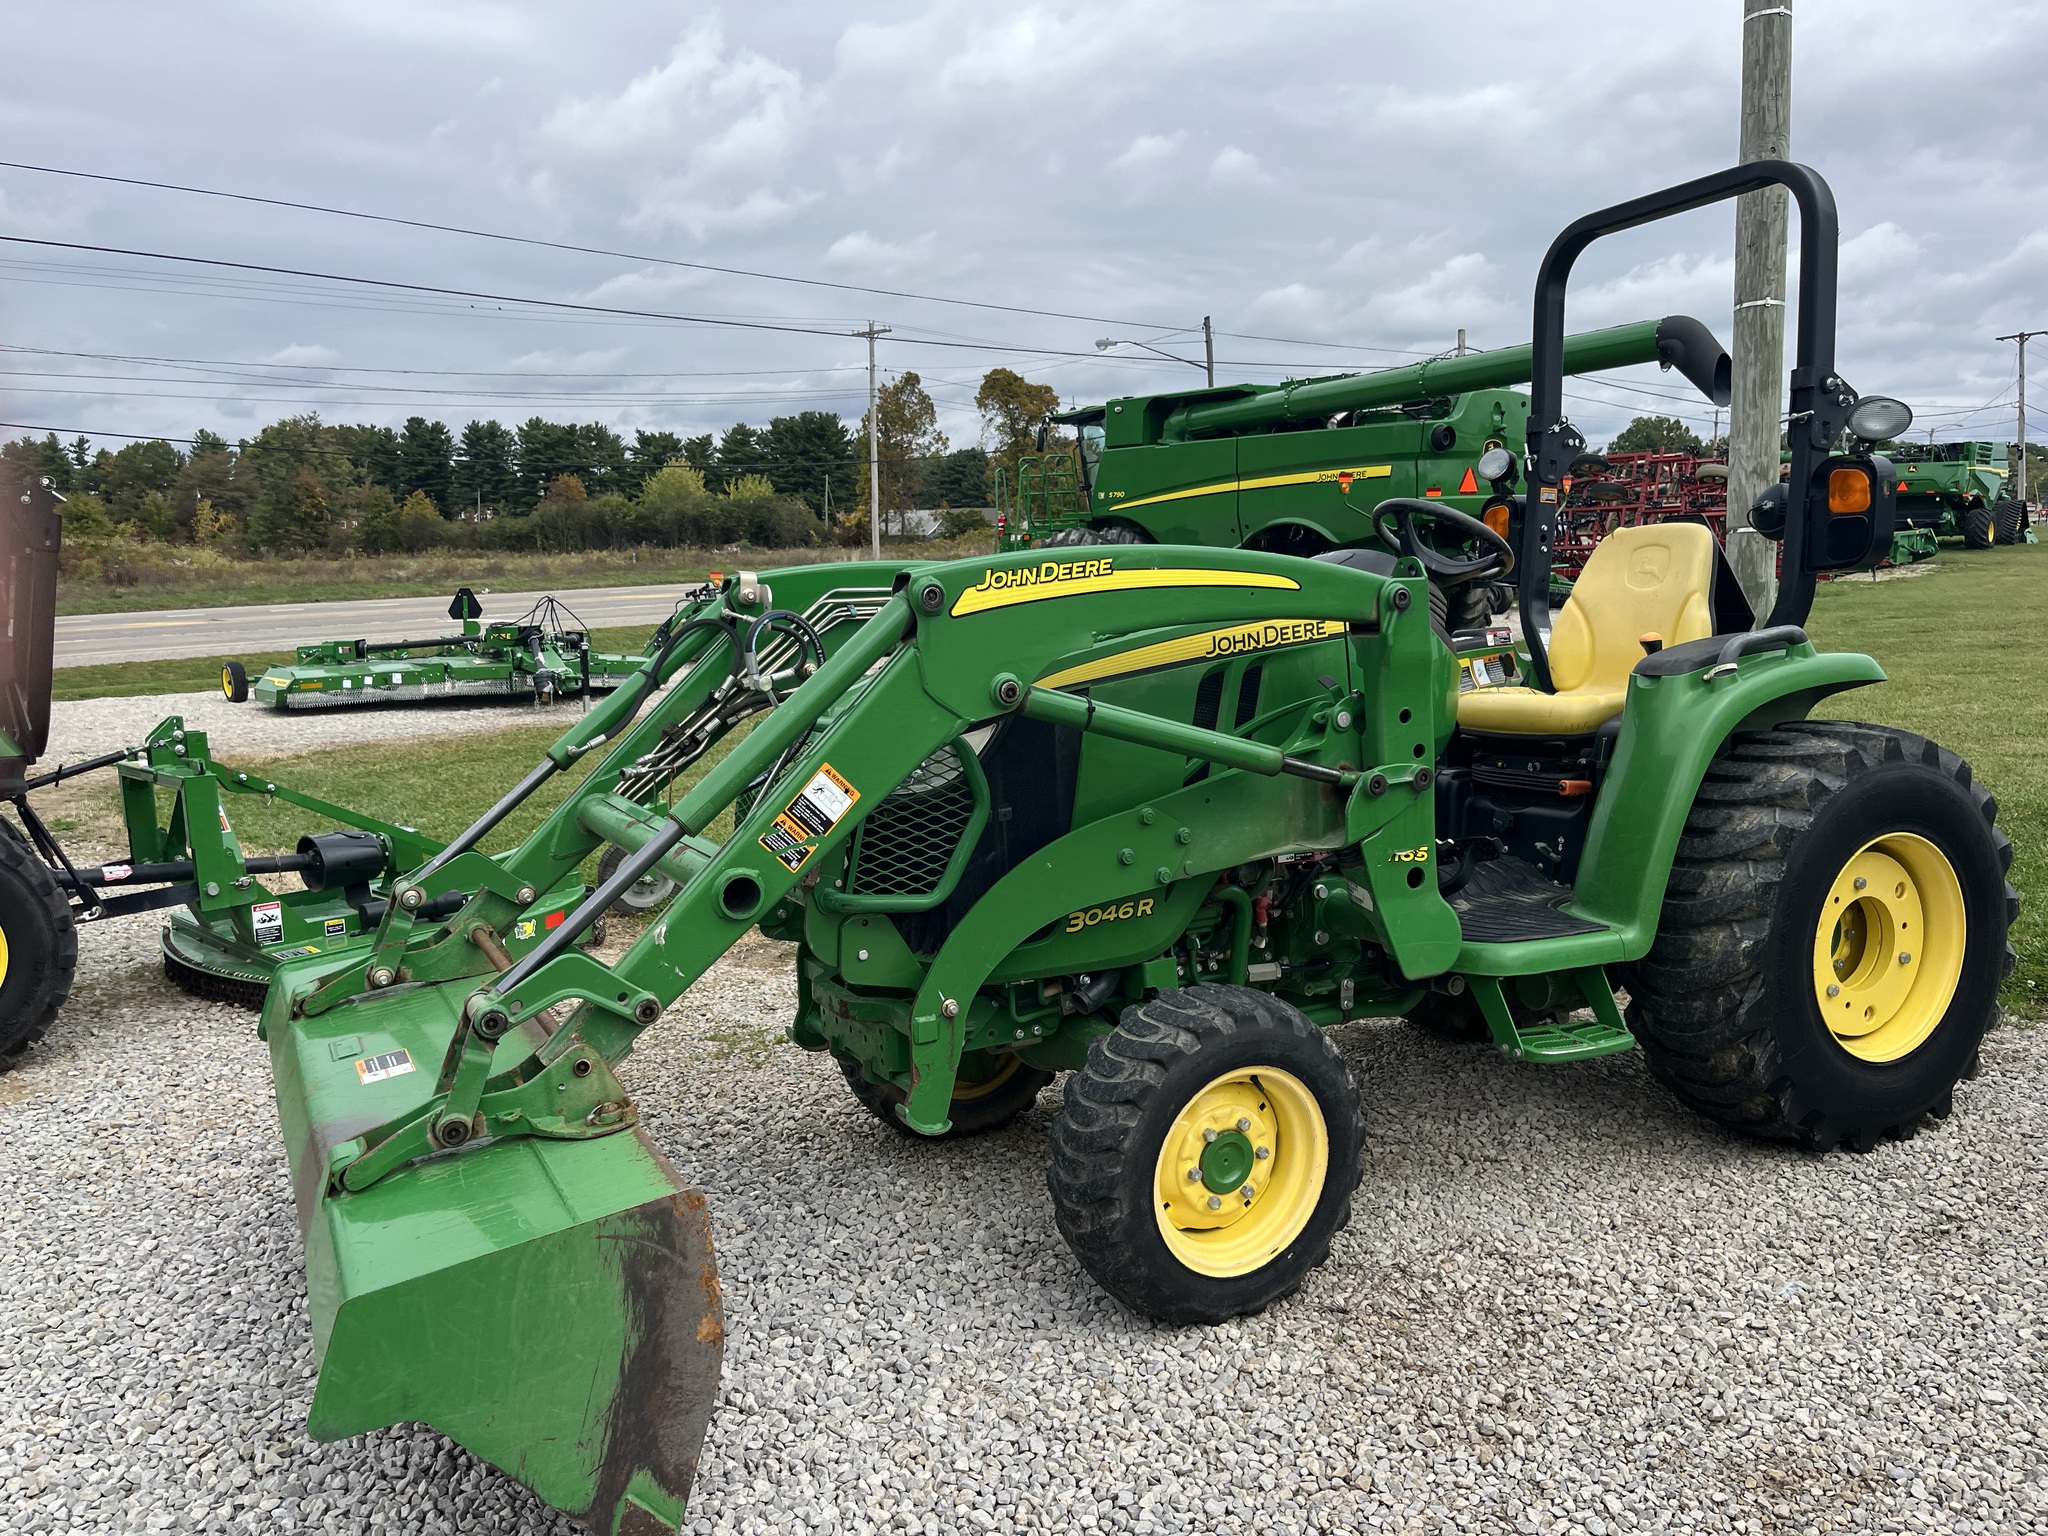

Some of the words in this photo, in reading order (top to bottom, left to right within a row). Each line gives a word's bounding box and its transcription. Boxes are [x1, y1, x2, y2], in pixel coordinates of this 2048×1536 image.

[1317, 473, 1339, 481] JOHN
[976, 565, 1040, 591] JOHN
[1040, 558, 1113, 587] DEERE
[1205, 631, 1262, 658] JOHN
[1264, 621, 1327, 648] DEERE
[1065, 897, 1155, 933] 3046R
